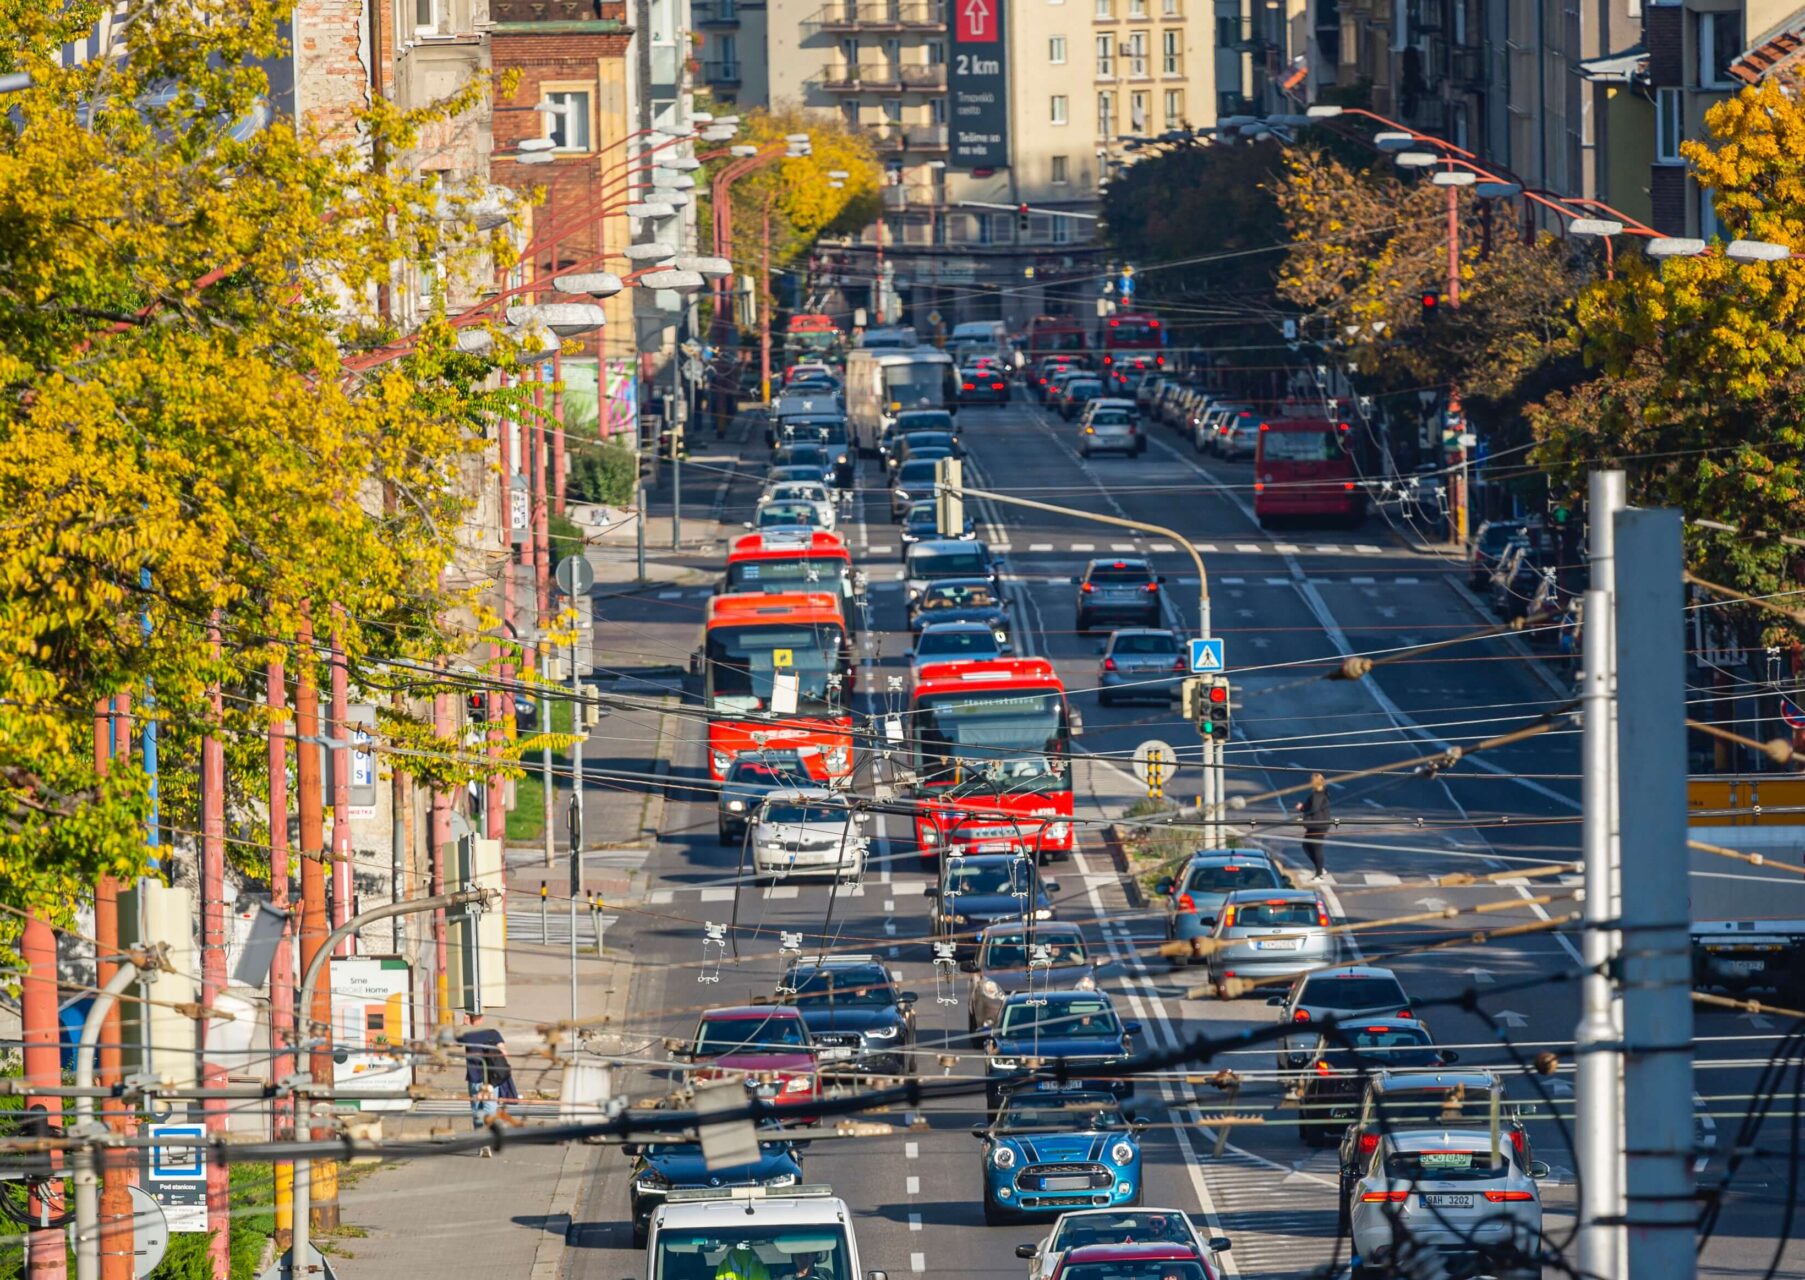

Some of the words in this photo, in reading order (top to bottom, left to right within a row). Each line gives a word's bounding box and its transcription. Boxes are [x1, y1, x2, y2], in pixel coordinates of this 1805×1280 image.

[956, 54, 969, 75] 2
[972, 54, 999, 75] km
[1449, 1195, 1470, 1205] 3202
